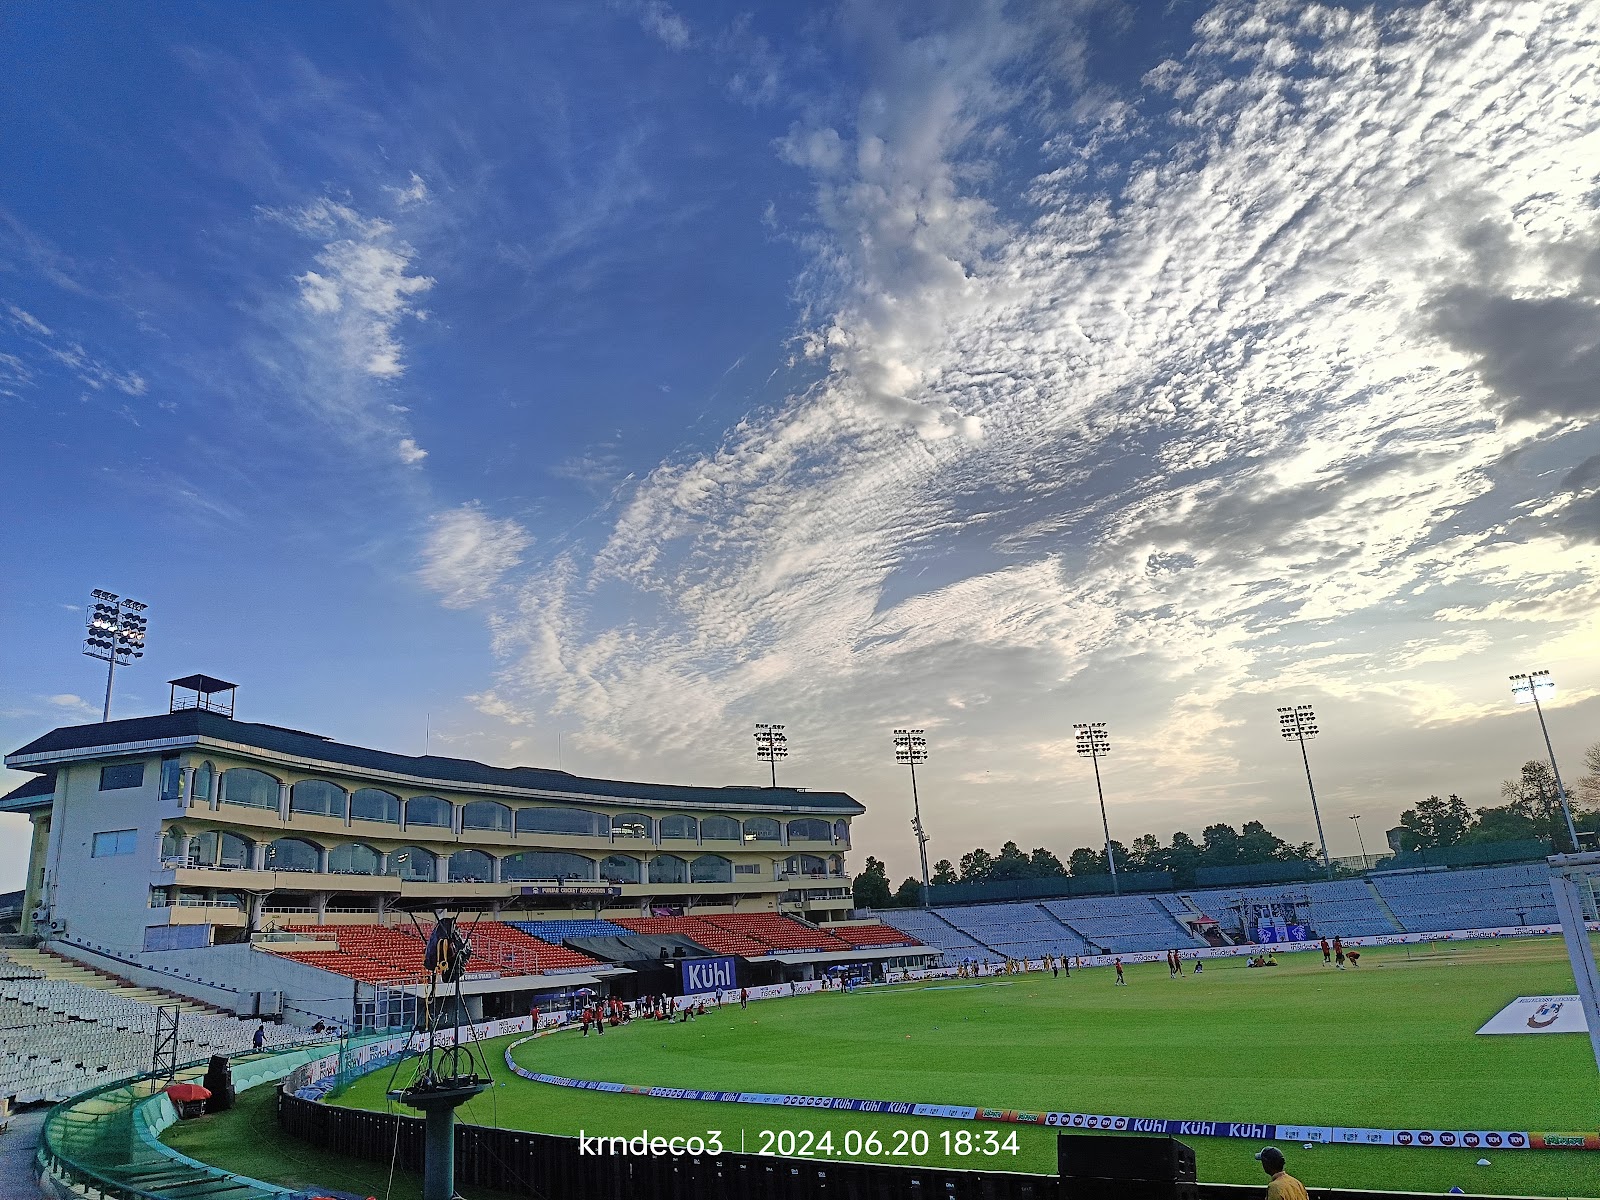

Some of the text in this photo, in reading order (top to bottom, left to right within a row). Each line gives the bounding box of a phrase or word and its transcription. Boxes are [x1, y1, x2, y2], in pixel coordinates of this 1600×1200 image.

[689, 961, 731, 990] Kühl
[887, 1101, 911, 1114] Kühl
[1133, 1118, 1267, 1139] Kühl Kühl Kühl
